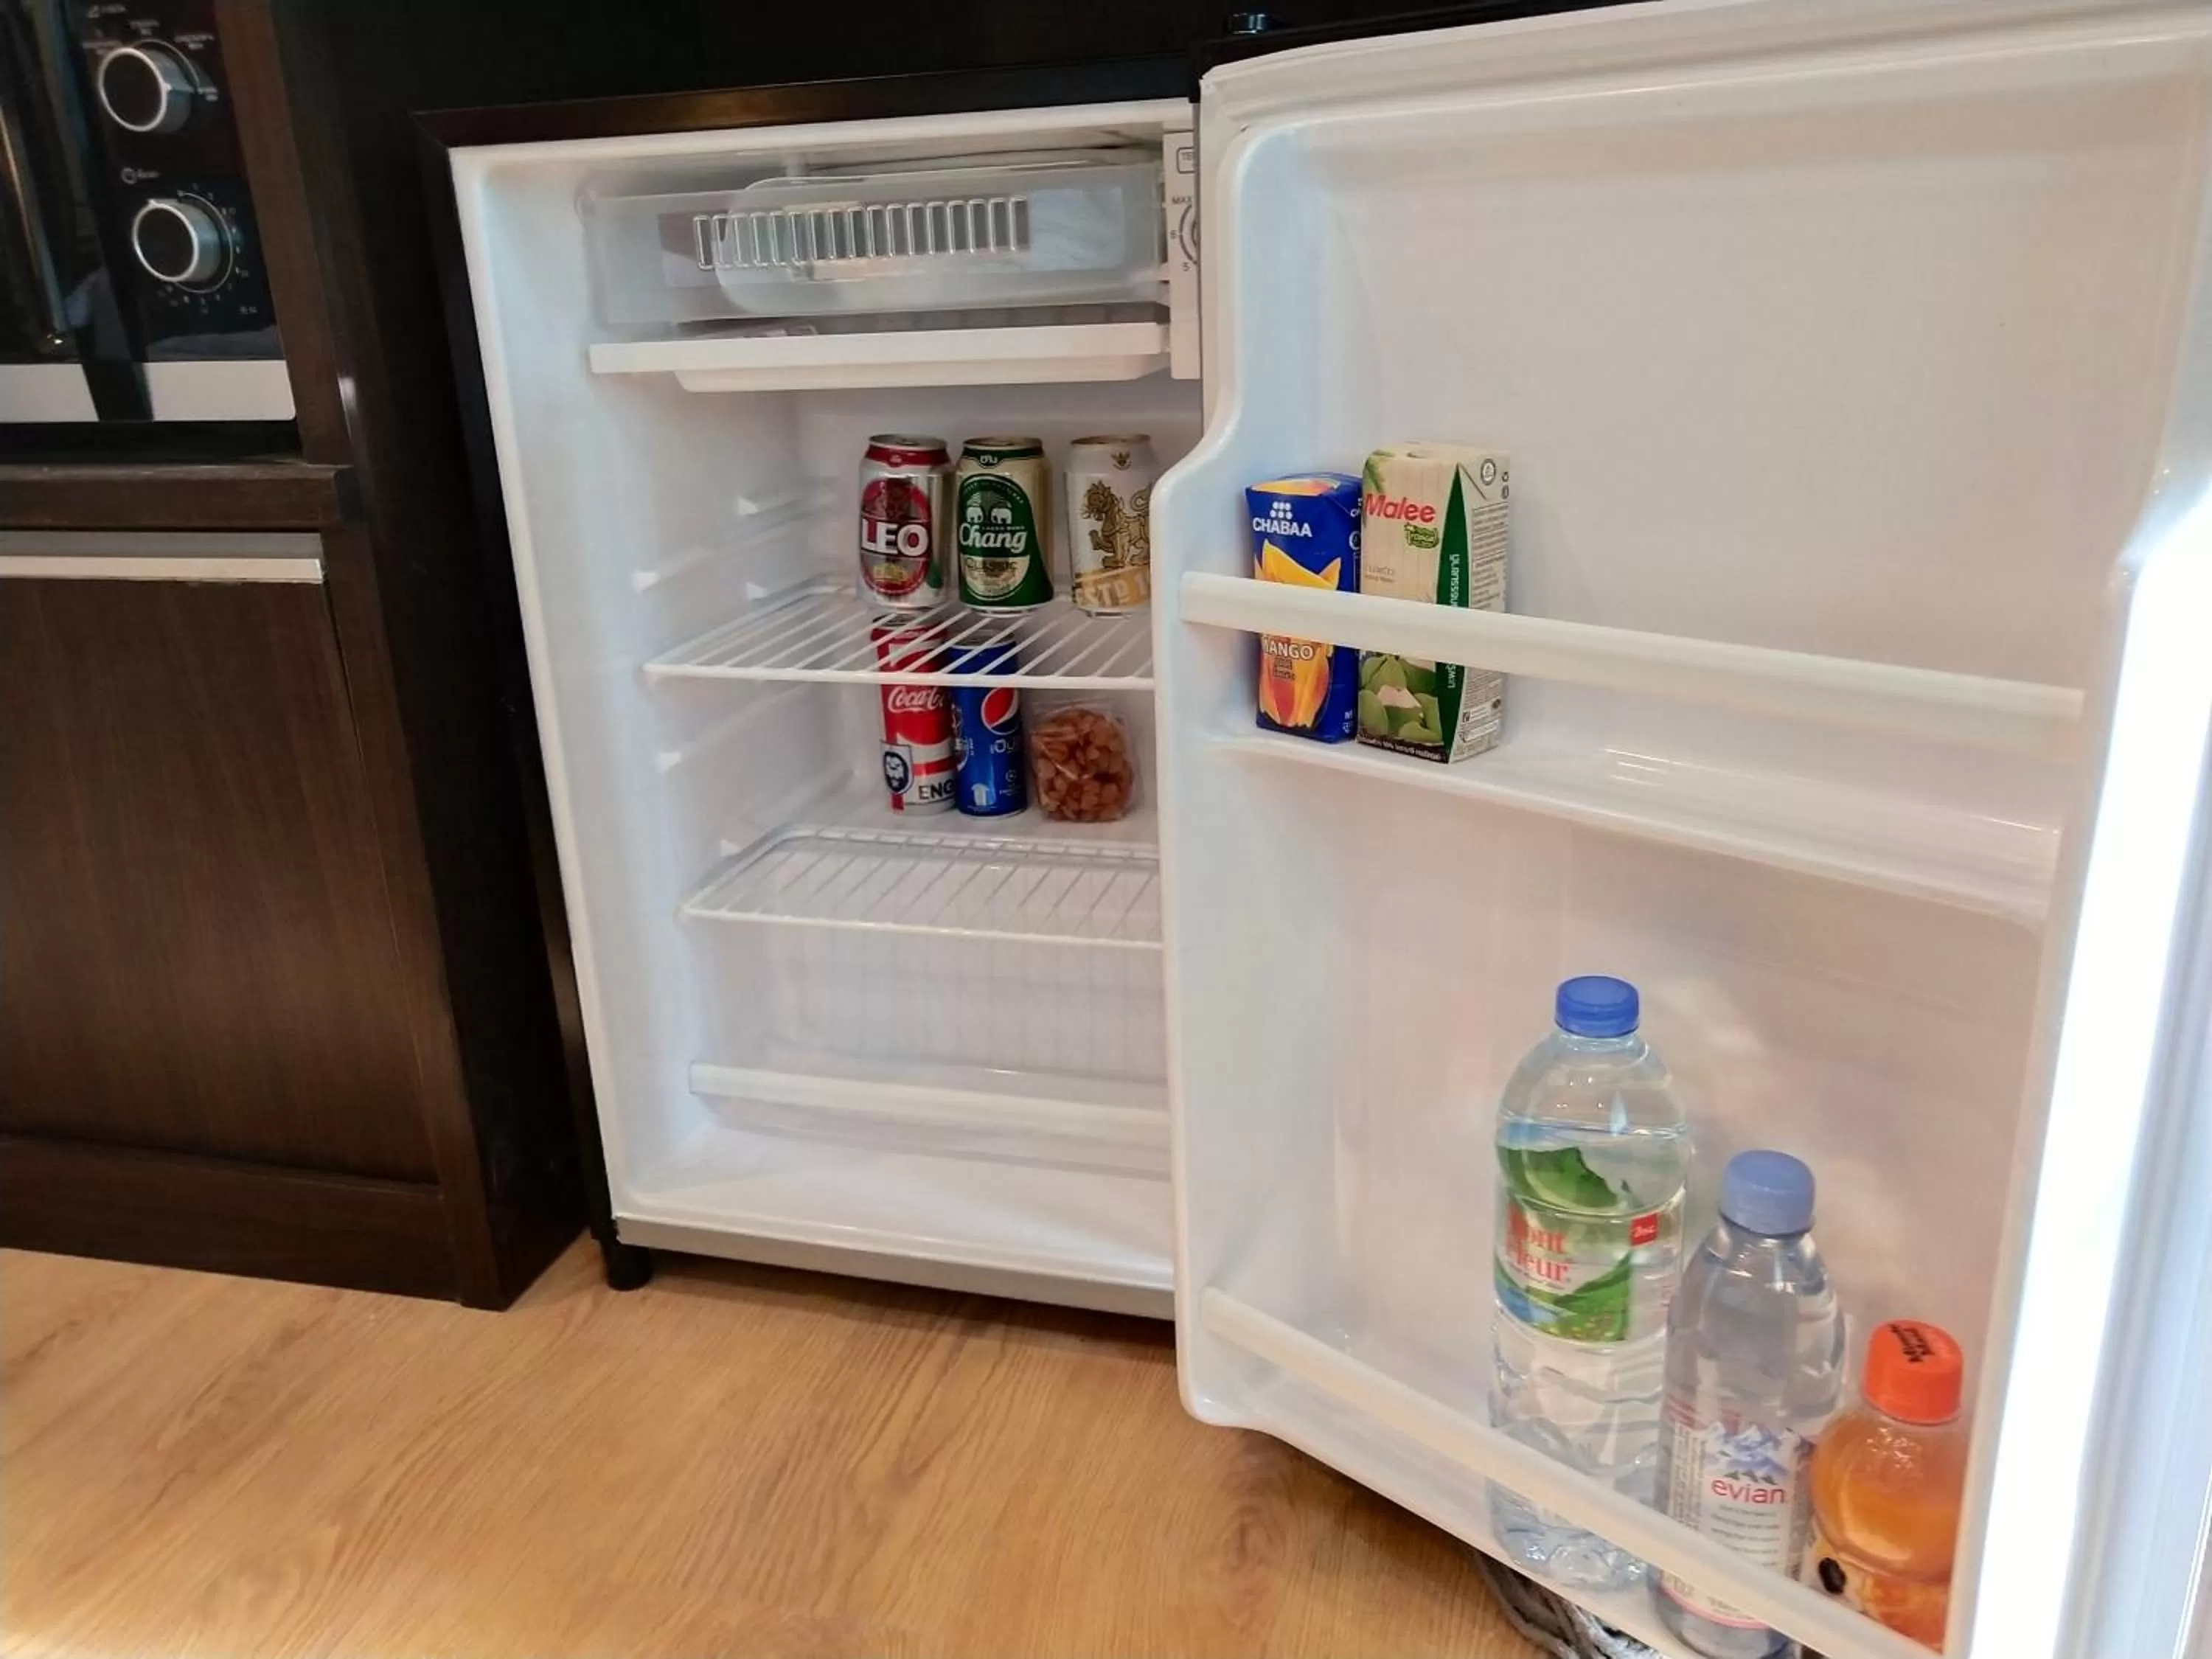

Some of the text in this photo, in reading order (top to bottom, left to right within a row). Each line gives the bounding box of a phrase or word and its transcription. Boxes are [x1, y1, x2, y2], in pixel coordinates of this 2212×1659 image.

[1366, 493, 1436, 523] Malee
[861, 518, 929, 557] LEO
[959, 523, 1028, 554] Chang
[1253, 517, 1312, 538] CHABAA
[1711, 1479, 1786, 1504] evian
